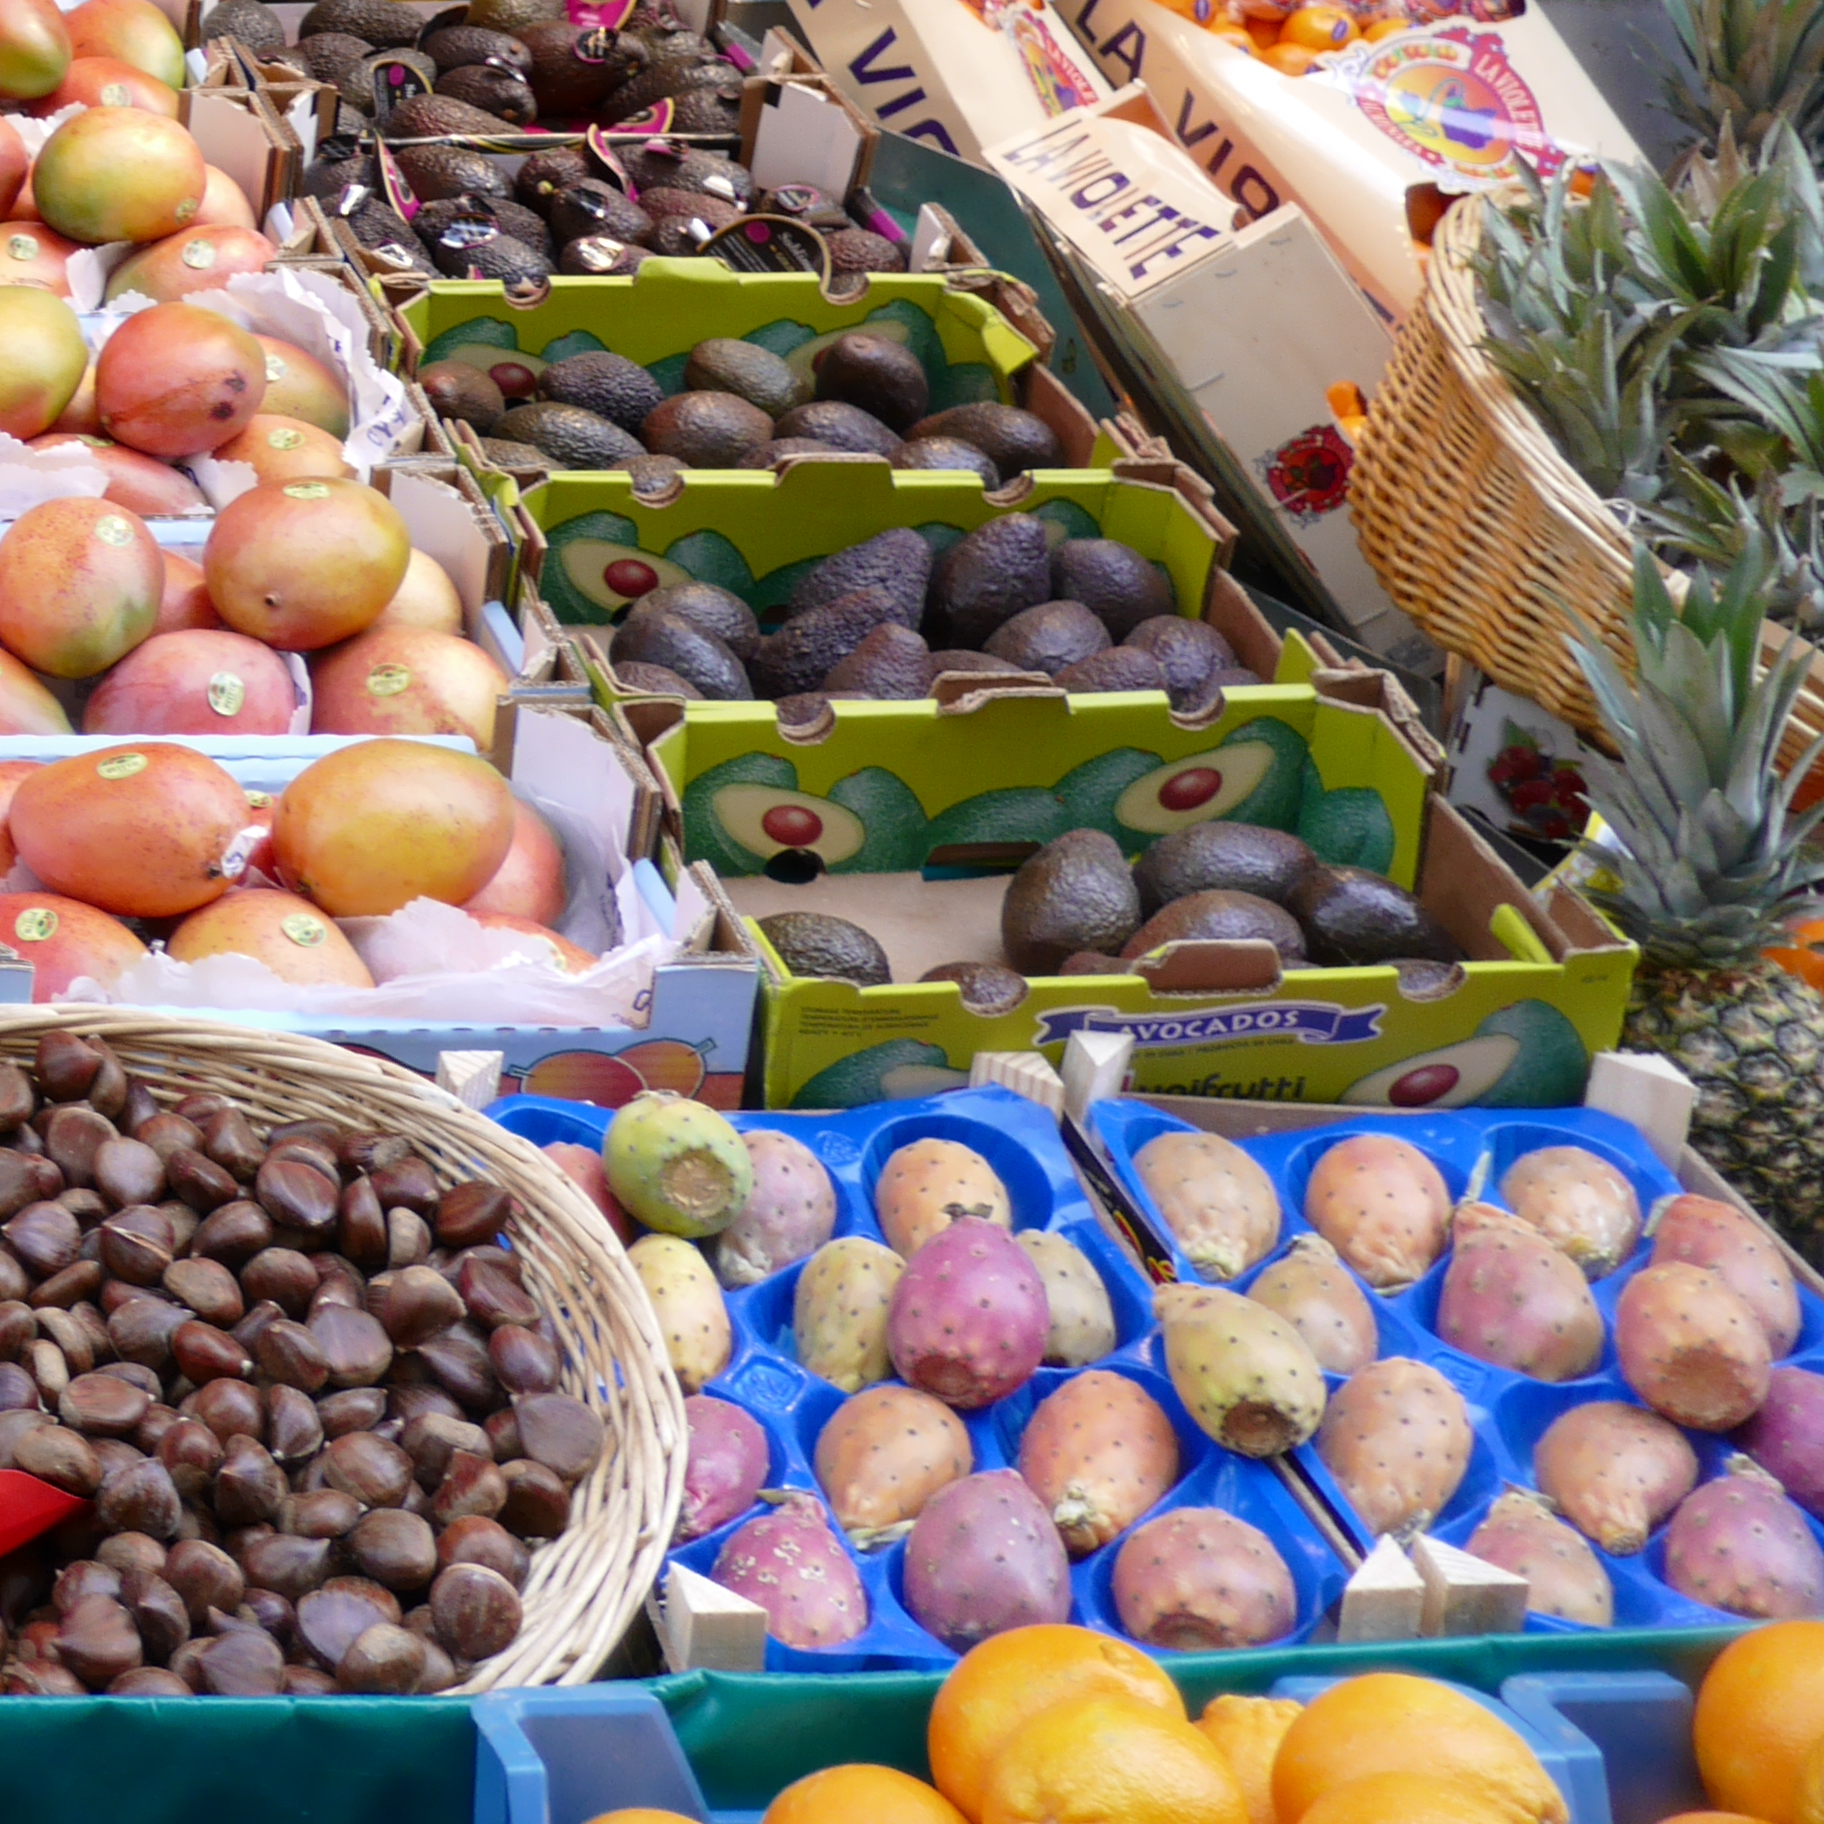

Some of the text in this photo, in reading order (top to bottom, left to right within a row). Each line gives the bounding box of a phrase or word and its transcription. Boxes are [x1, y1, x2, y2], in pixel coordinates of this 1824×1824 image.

[1474, 54, 1499, 83] LA
[1002, 125, 1226, 283] LA VIOLETTE
[1119, 1009, 1300, 1042] AVOCADOS
